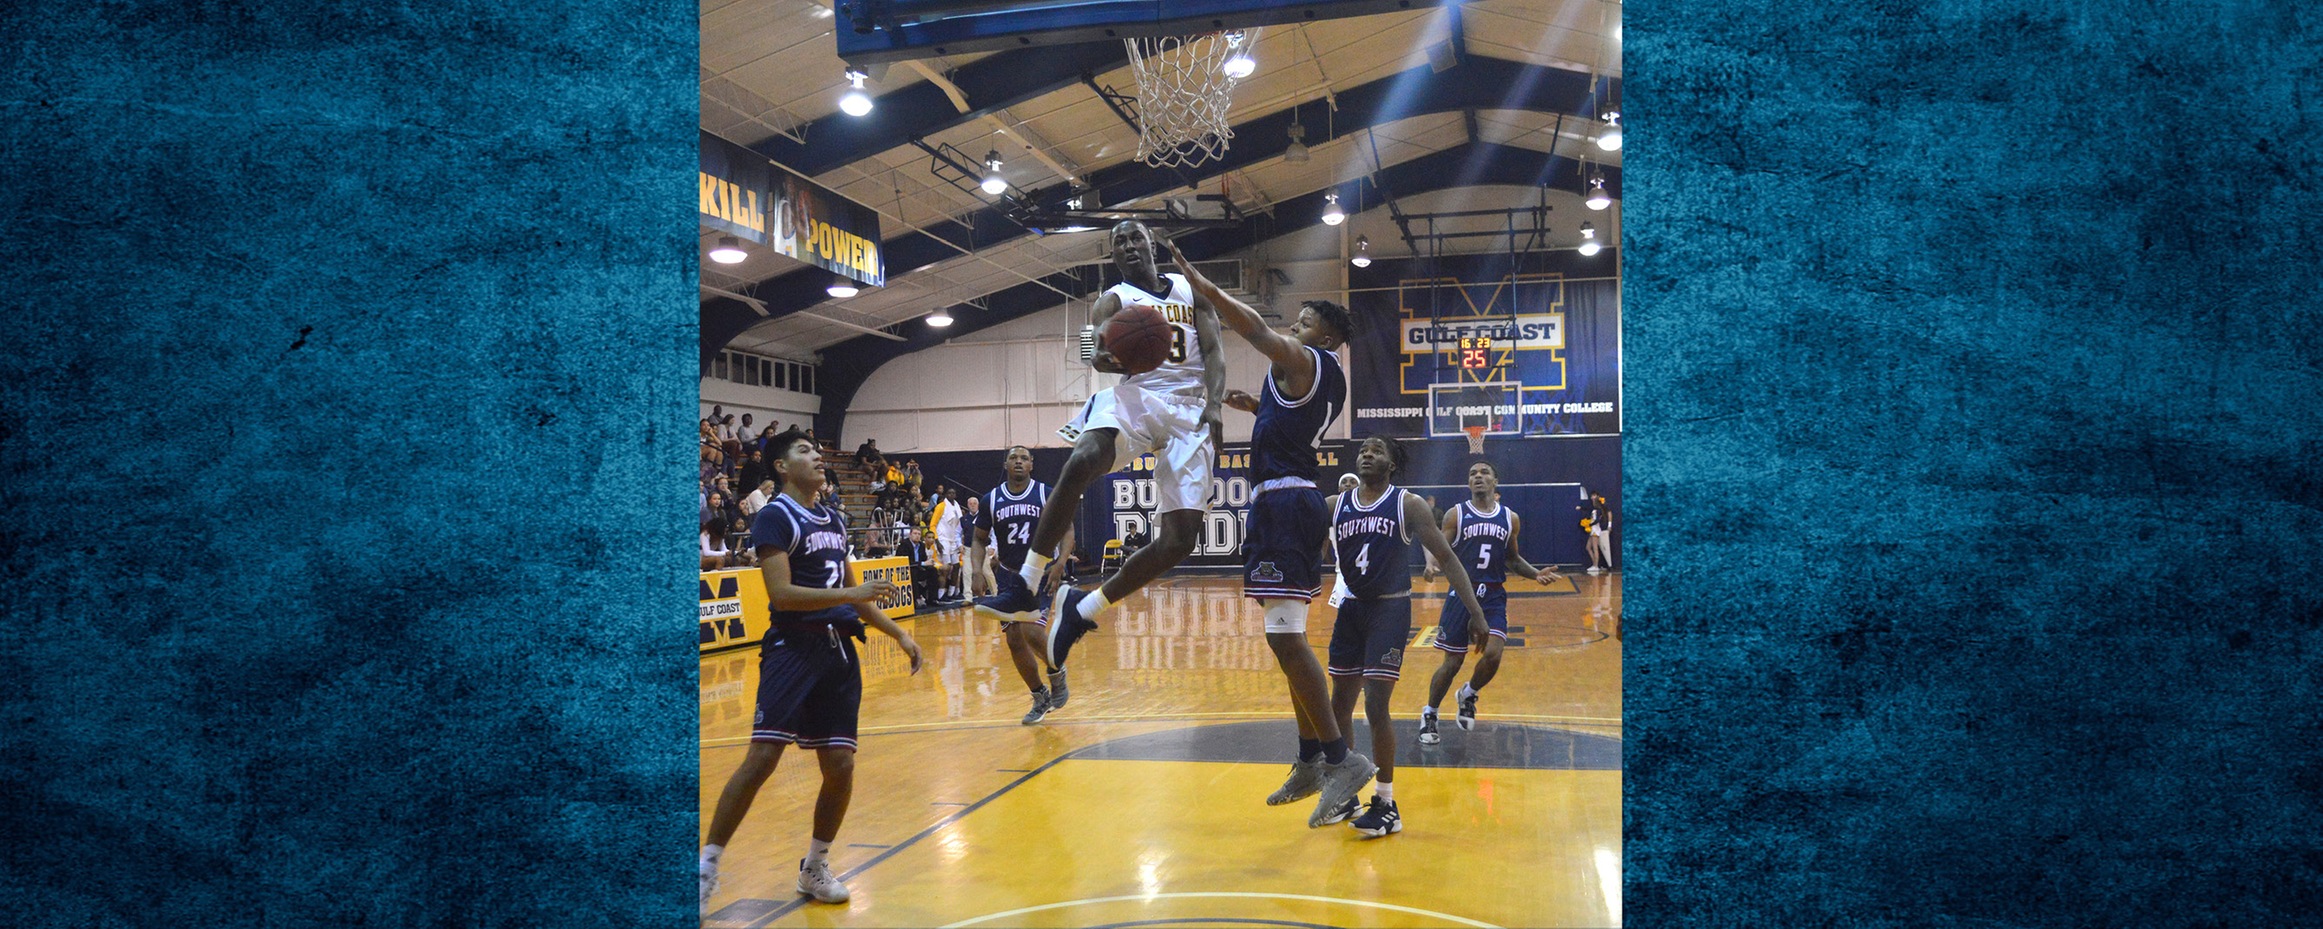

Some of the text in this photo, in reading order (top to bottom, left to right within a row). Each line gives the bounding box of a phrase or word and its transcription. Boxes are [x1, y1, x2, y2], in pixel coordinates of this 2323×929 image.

[700, 171, 764, 234] KILL
[806, 218, 878, 276] POWER
[1166, 304, 1193, 326] COAS
[1409, 323, 1556, 344] GULF COAST
[1463, 350, 1486, 368] 25
[1357, 408, 1423, 418] MISSISSIPPI
[1563, 402, 1614, 413] COLLEGE
[996, 504, 1041, 522] SOUTHWEST
[1007, 522, 1030, 544] 24
[1337, 516, 1395, 541] SOUTHWEST
[1463, 522, 1508, 541] SOUTHWEST
[1355, 543, 1370, 575] 4
[1476, 543, 1492, 570] 5
[863, 566, 910, 583] HOME OF THE
[700, 602, 740, 617] ULF COAST
